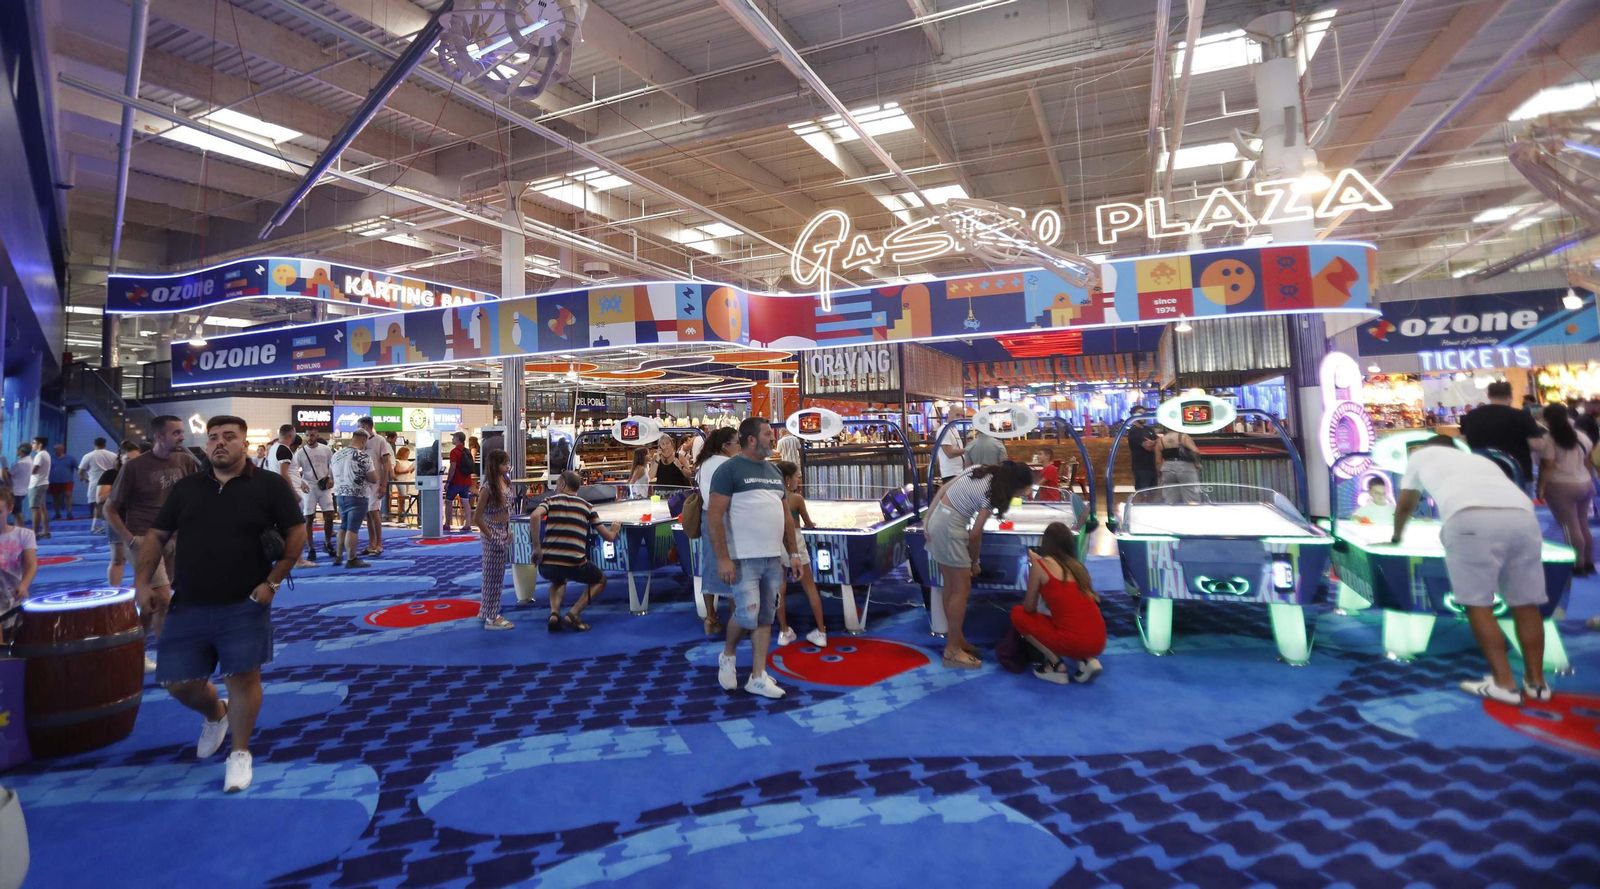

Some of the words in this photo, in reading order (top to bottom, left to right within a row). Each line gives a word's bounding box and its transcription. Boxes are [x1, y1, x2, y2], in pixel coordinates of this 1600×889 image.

[1095, 168, 1393, 245] PLAZA
[151, 279, 214, 303] ozone
[344, 275, 434, 307] KARTING
[1153, 297, 1177, 306] since
[1155, 306, 1177, 314] 1974
[1400, 310, 1538, 337] ozone
[200, 343, 276, 371] ozone
[296, 362, 321, 371] BOWLING
[811, 349, 890, 377] CRAVING
[1419, 347, 1532, 371] TICKETS
[820, 376, 886, 389] Burgers
[576, 397, 587, 406] DEL
